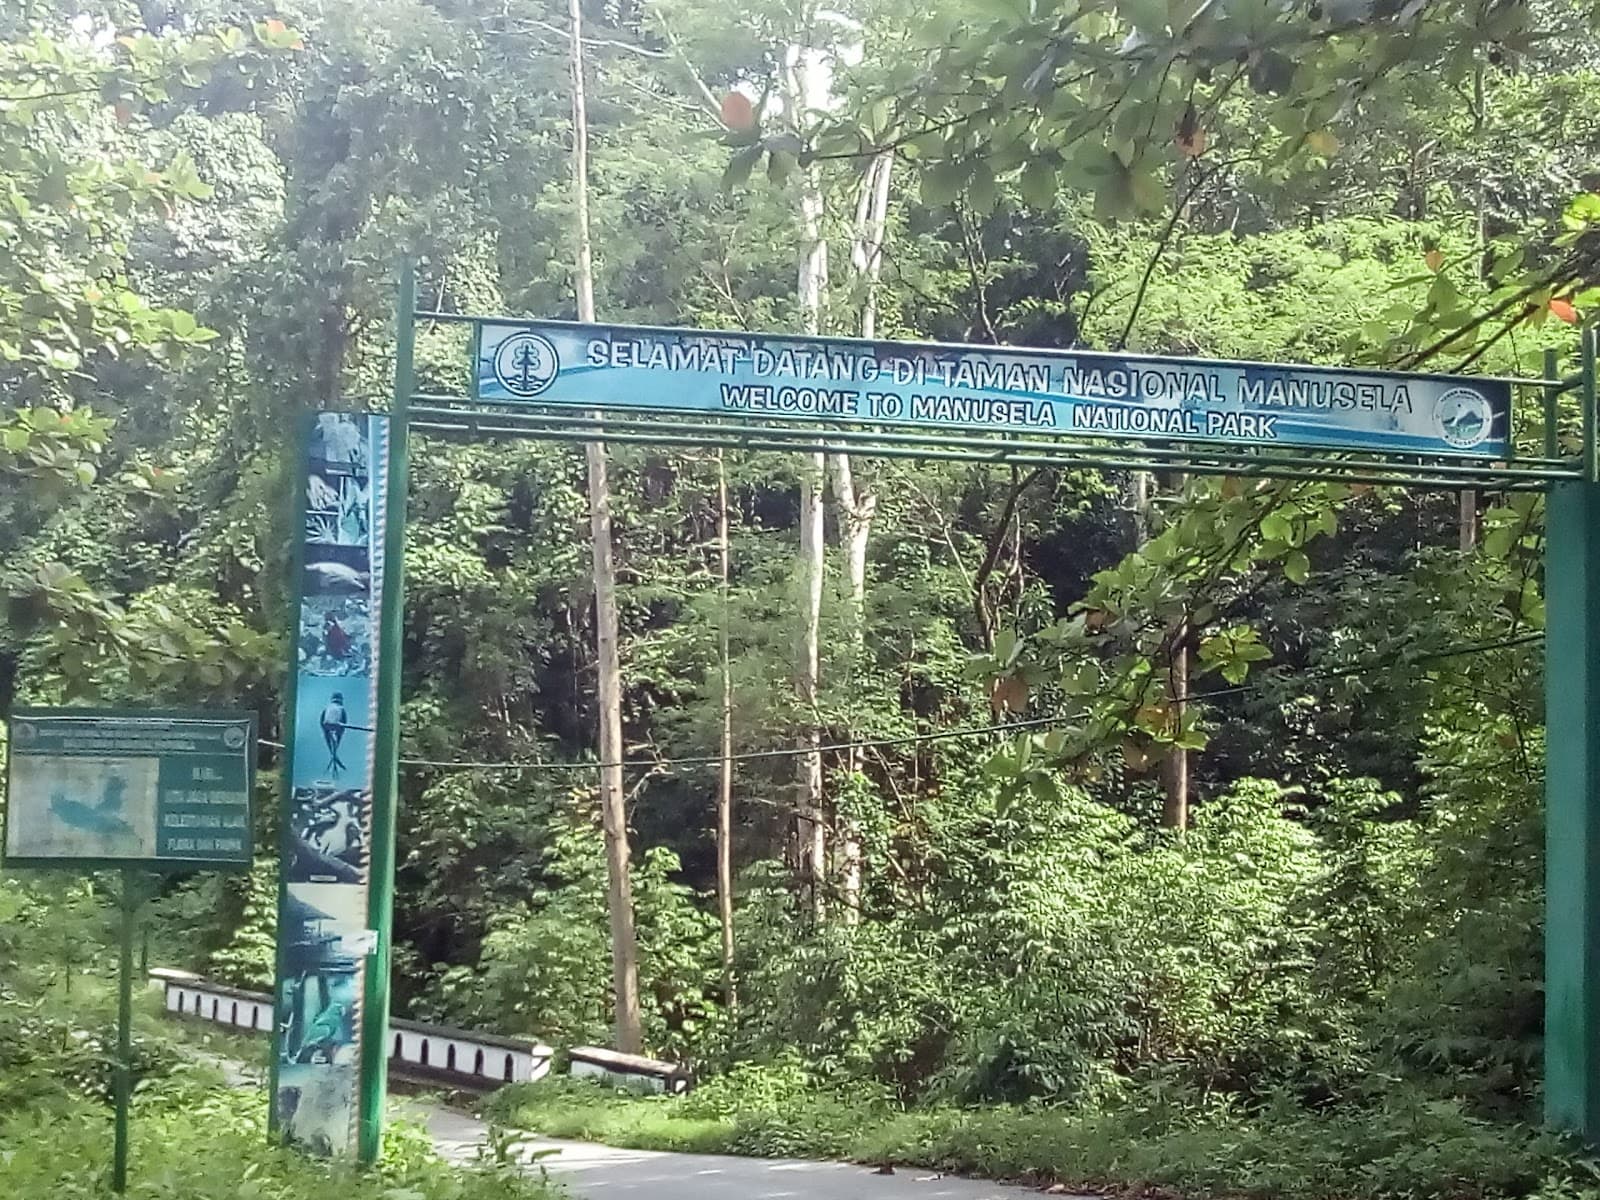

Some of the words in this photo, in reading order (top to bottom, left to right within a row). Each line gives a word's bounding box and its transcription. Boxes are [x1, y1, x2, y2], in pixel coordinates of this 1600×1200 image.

[586, 339, 741, 375] SELAMAT
[753, 348, 881, 381] DATANG
[893, 358, 927, 386] DI
[942, 360, 1051, 394] TAMAN
[1062, 367, 1226, 402] NASIONAL
[1238, 377, 1412, 414] MANUSELA
[720, 383, 859, 415] WELCOME
[869, 394, 903, 418] TO
[911, 397, 1056, 427] MANUSELA
[1073, 404, 1199, 434] NATIONAL
[1205, 413, 1278, 439] PARK
